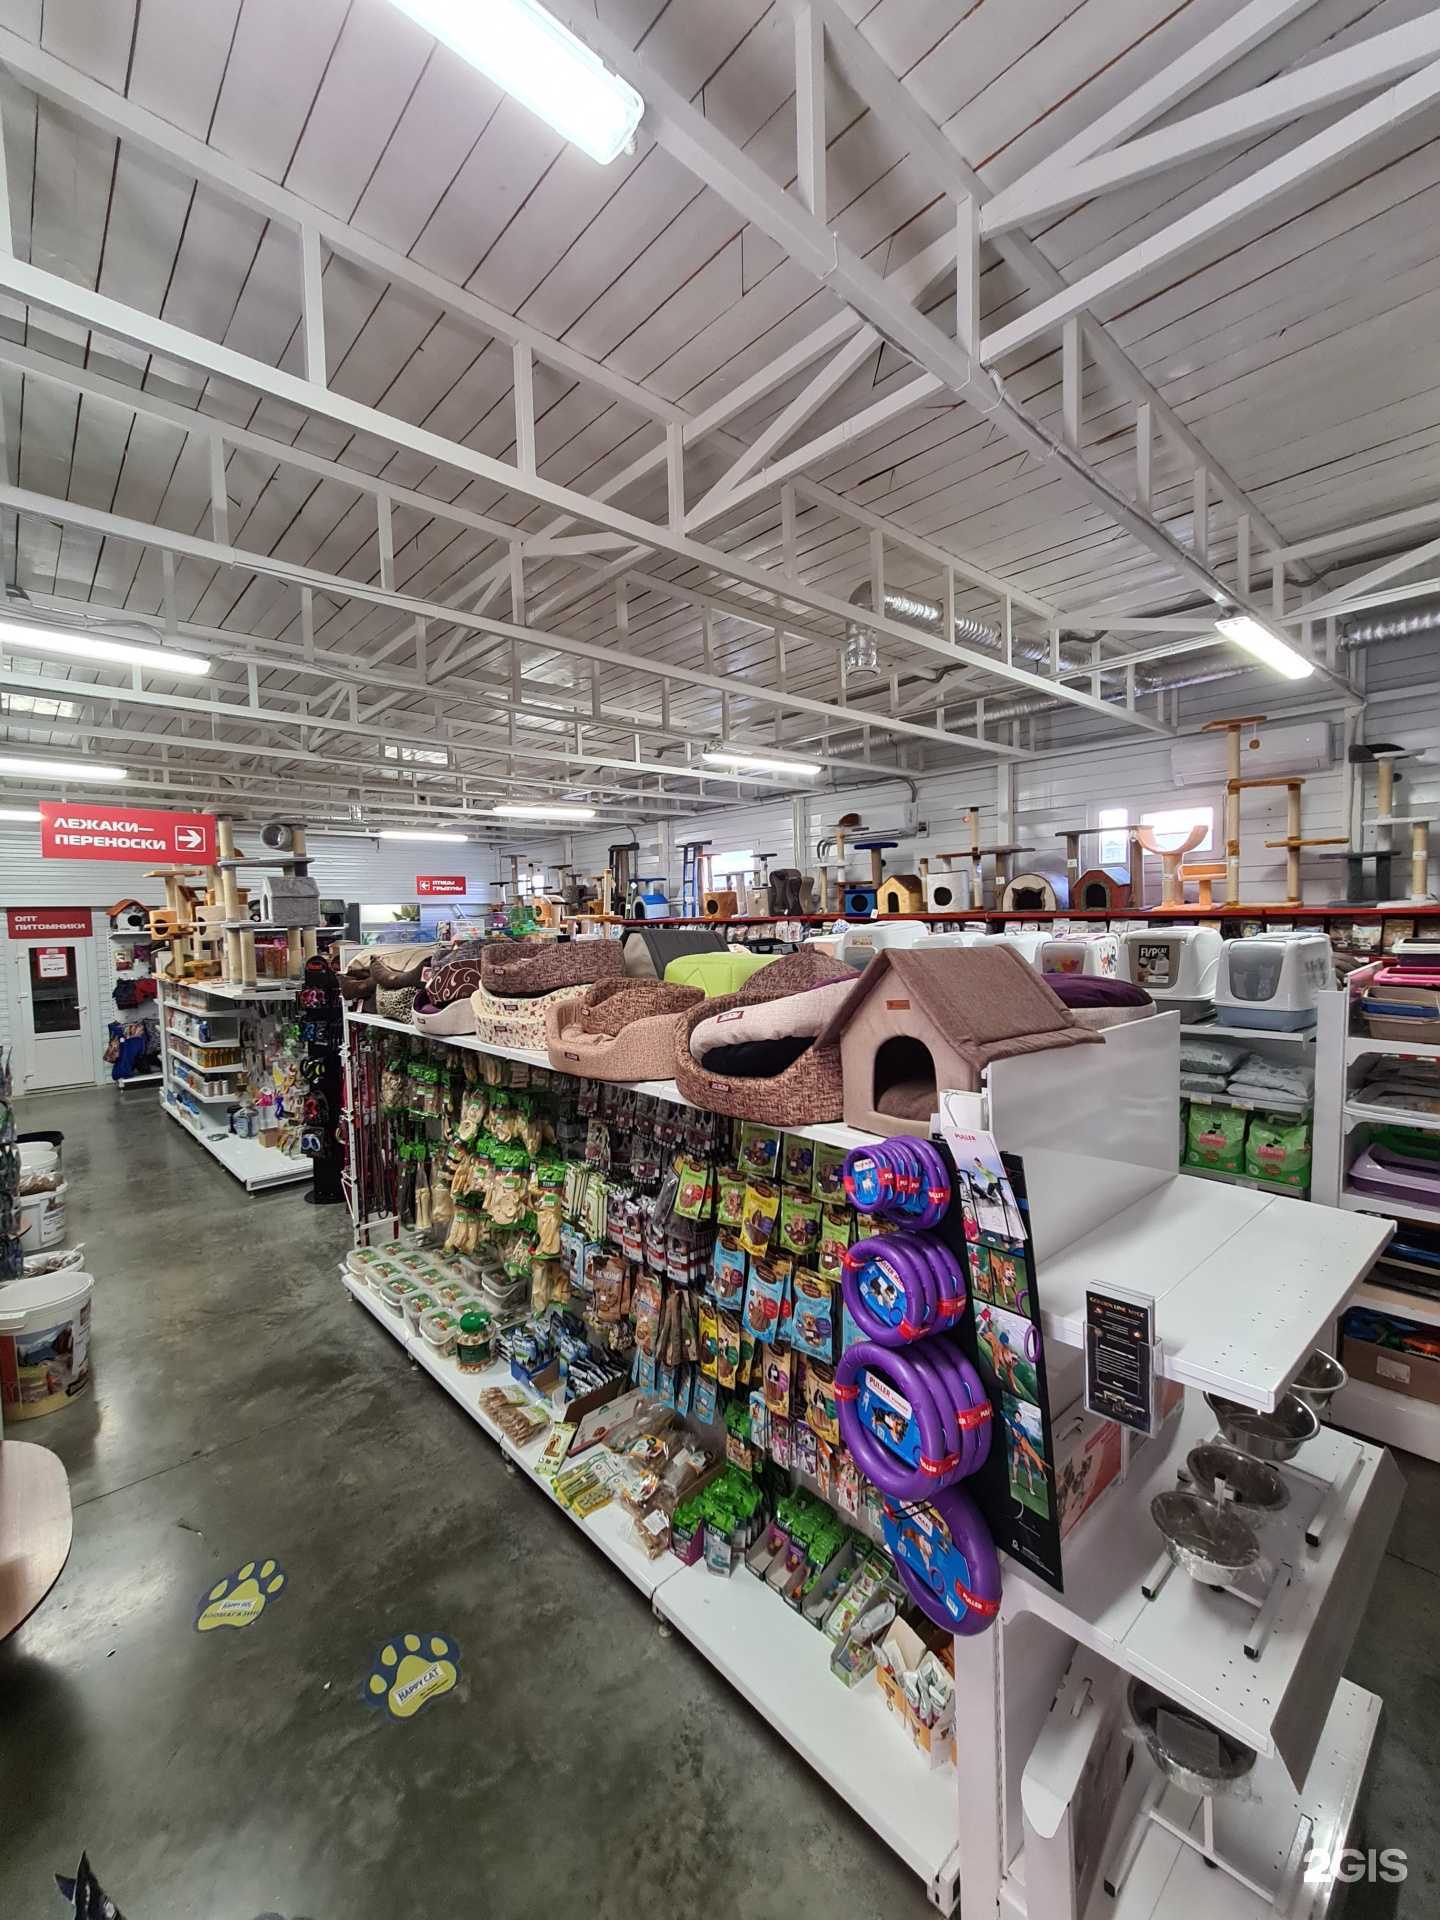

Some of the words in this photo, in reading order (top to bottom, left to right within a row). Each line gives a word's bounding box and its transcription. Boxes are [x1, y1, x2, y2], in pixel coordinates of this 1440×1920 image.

[55, 834, 166, 850] ПЕРЕНОСКИ
[16, 923, 86, 931] ПИТОМНИКИ
[869, 1375, 892, 1398] PULLER
[962, 1591, 983, 1609] PULLER
[398, 1680, 423, 1702] HAPPY
[423, 1667, 439, 1682] CAT
